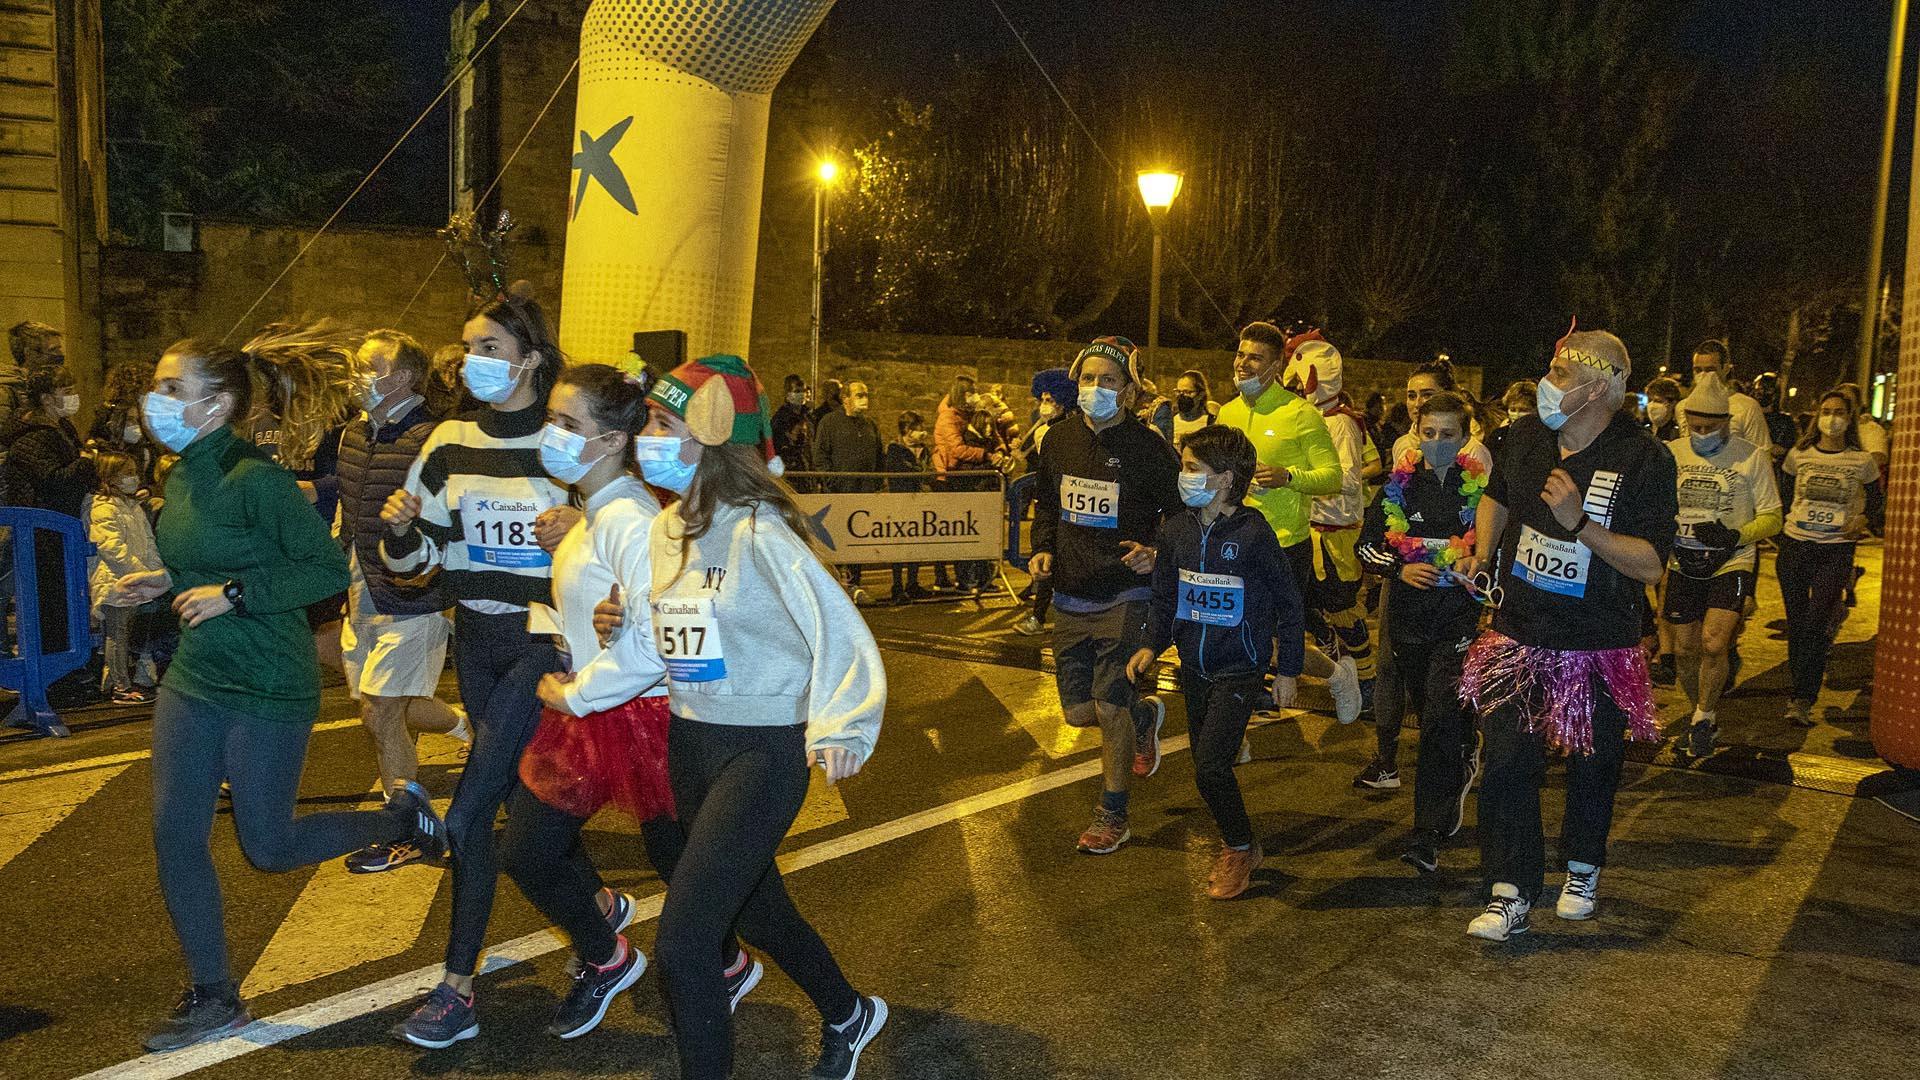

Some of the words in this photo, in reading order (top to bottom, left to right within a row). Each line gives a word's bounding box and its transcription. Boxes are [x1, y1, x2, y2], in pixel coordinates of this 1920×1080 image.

[1078, 480, 1108, 491] CaixaBank
[492, 501, 538, 512] CaixaBank
[1067, 492, 1110, 514] 1516
[847, 510, 980, 538] CaixaBank
[1808, 510, 1834, 524] 969
[1540, 538, 1577, 555] CaixaBank
[1526, 548, 1579, 580] 1026
[702, 567, 727, 590] NY
[1197, 576, 1232, 586] CaixaBank
[1186, 588, 1235, 611] 4455
[662, 603, 701, 615] CaixaBank
